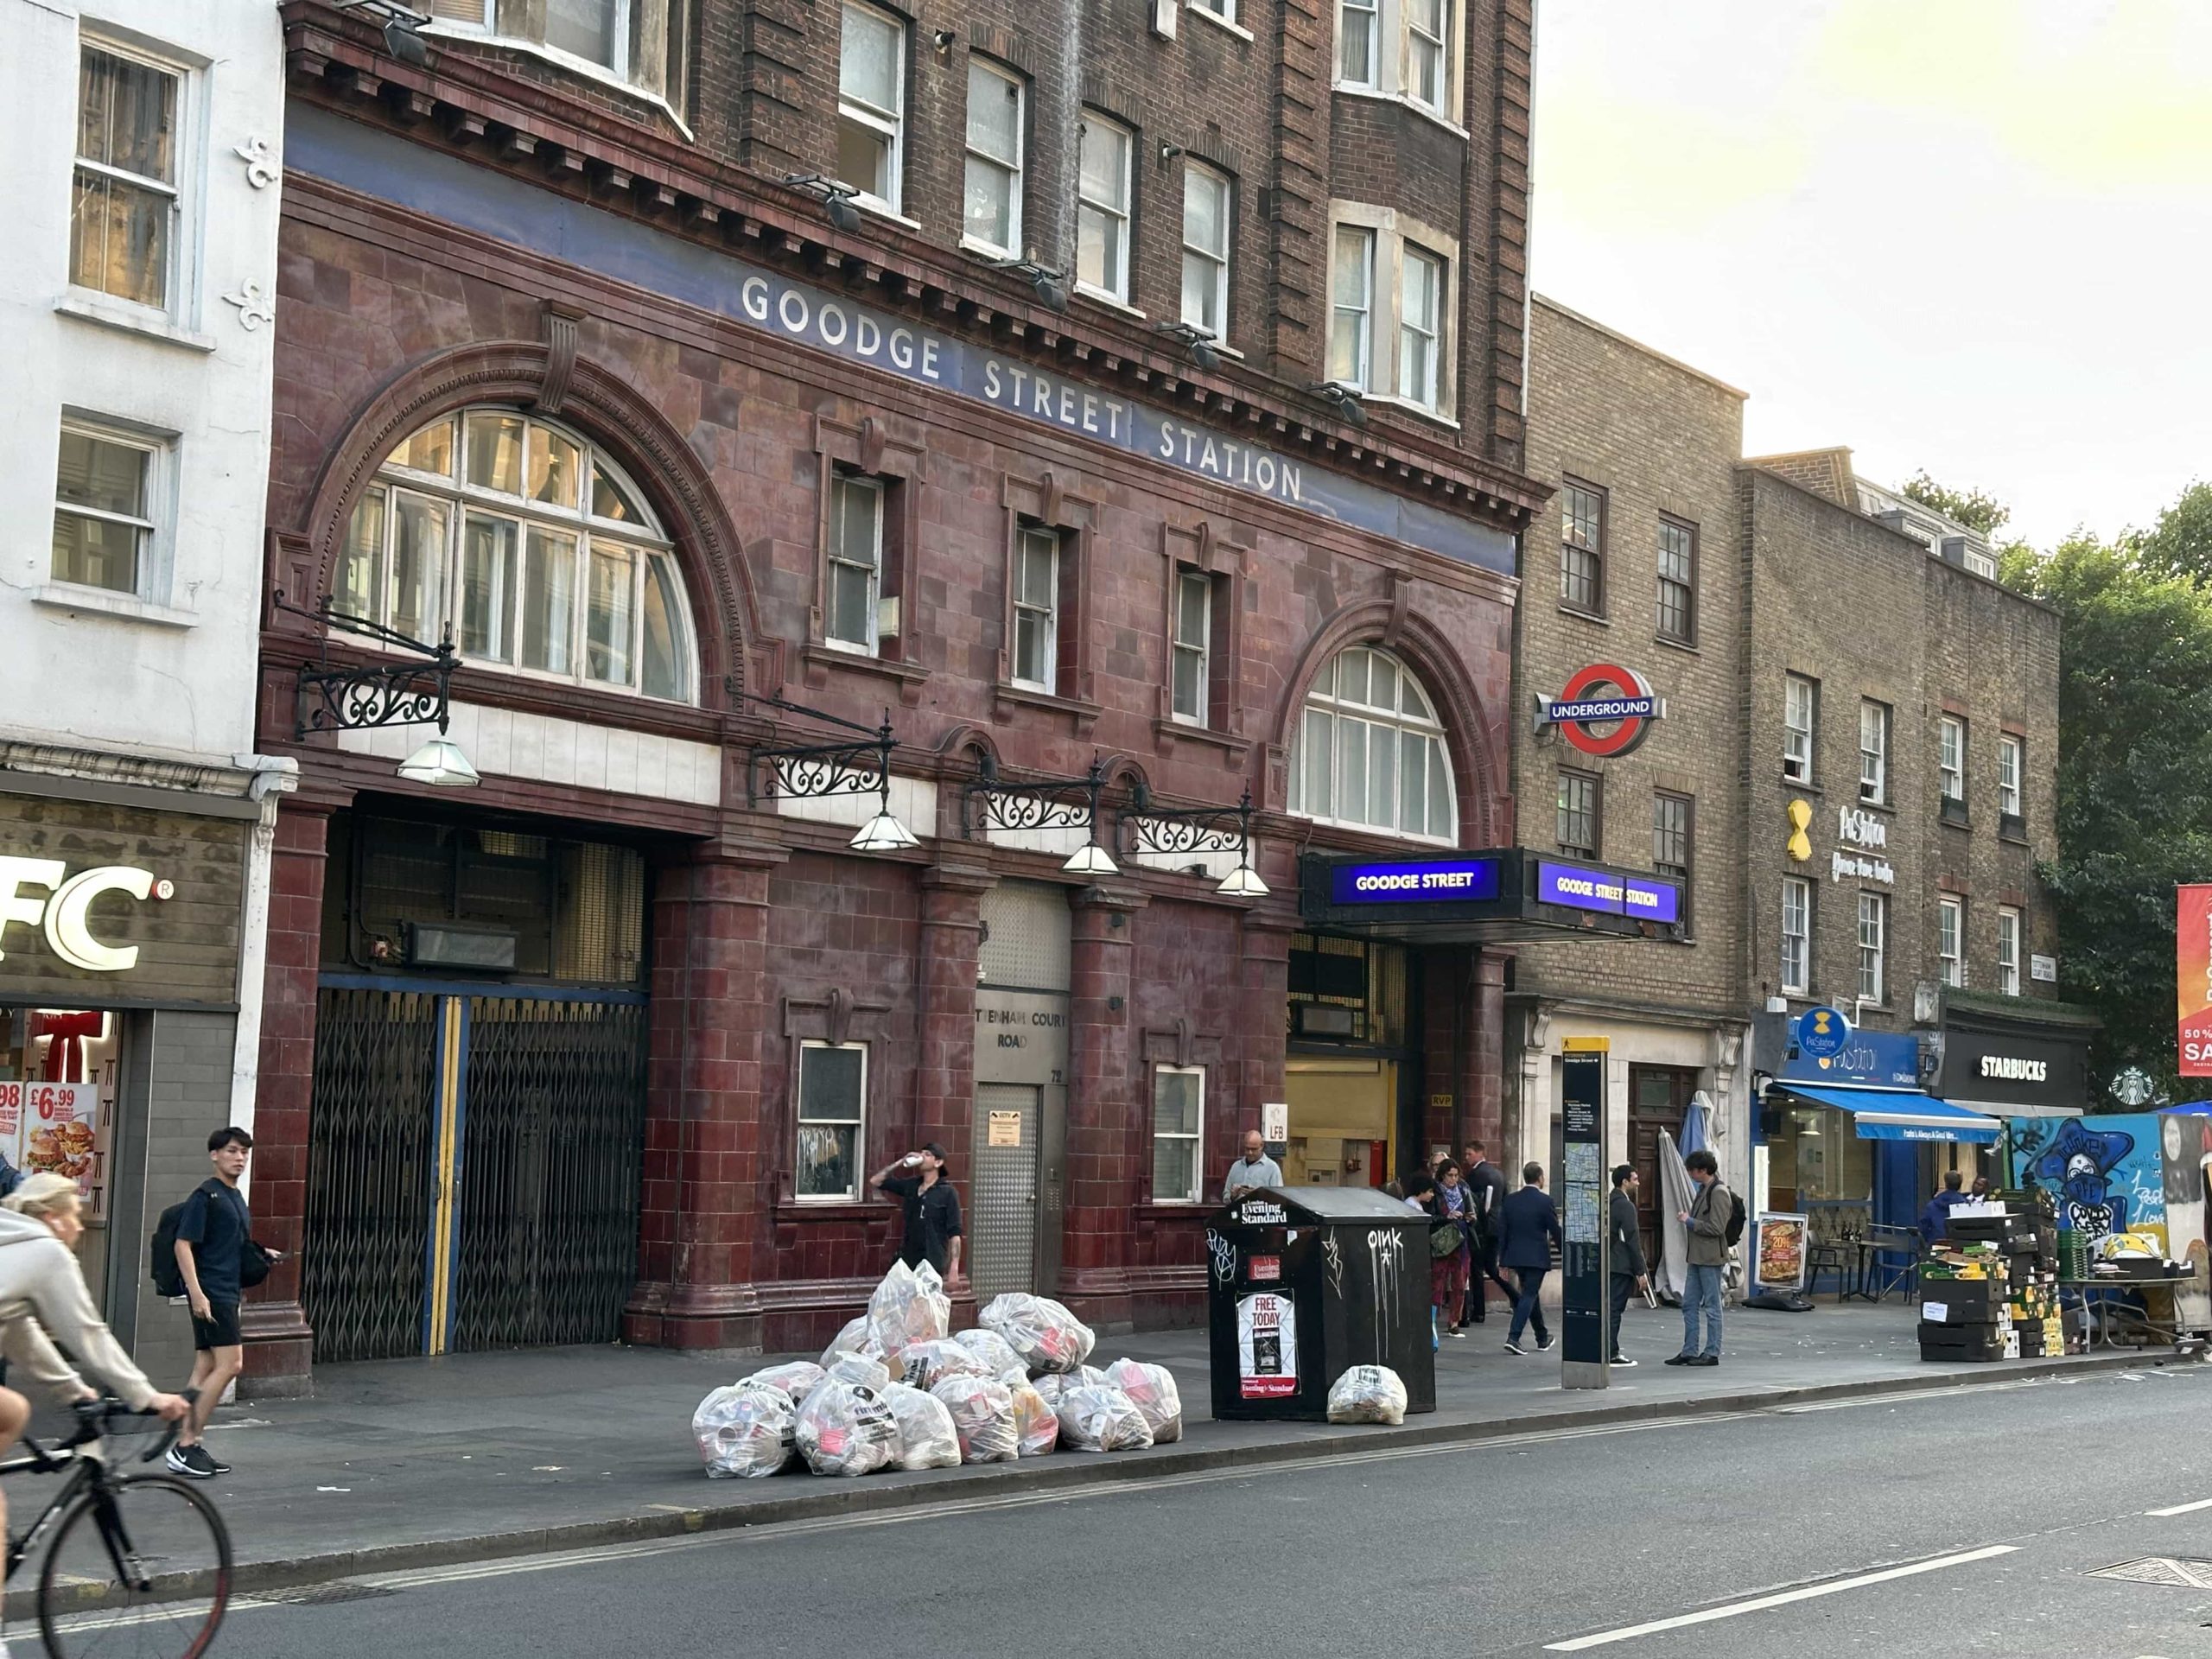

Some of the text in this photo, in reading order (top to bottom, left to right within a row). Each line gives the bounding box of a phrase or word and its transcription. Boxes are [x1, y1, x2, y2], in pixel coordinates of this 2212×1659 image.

[741, 276, 1300, 501] GOODGE STREET STATION
[1552, 701, 1649, 718] UNDERGROUND
[1356, 872, 1474, 891] GOODGE STREET
[1557, 877, 1658, 907] GOODGE STREET STATION
[997, 1034, 1027, 1049] ROAD
[1981, 1055, 2047, 1082] STARBUCKS
[1051, 1070, 1063, 1084] 72
[29, 1087, 75, 1120] £6.99
[1433, 1096, 1452, 1105] RVP
[1270, 1126, 1284, 1140] LFB
[1242, 1202, 1281, 1214] Evening
[1242, 1211, 1287, 1224] Standard
[1772, 1236, 1790, 1249] 20%
[1255, 1297, 1277, 1311] FREE
[1252, 1313, 1281, 1326] TODAY
